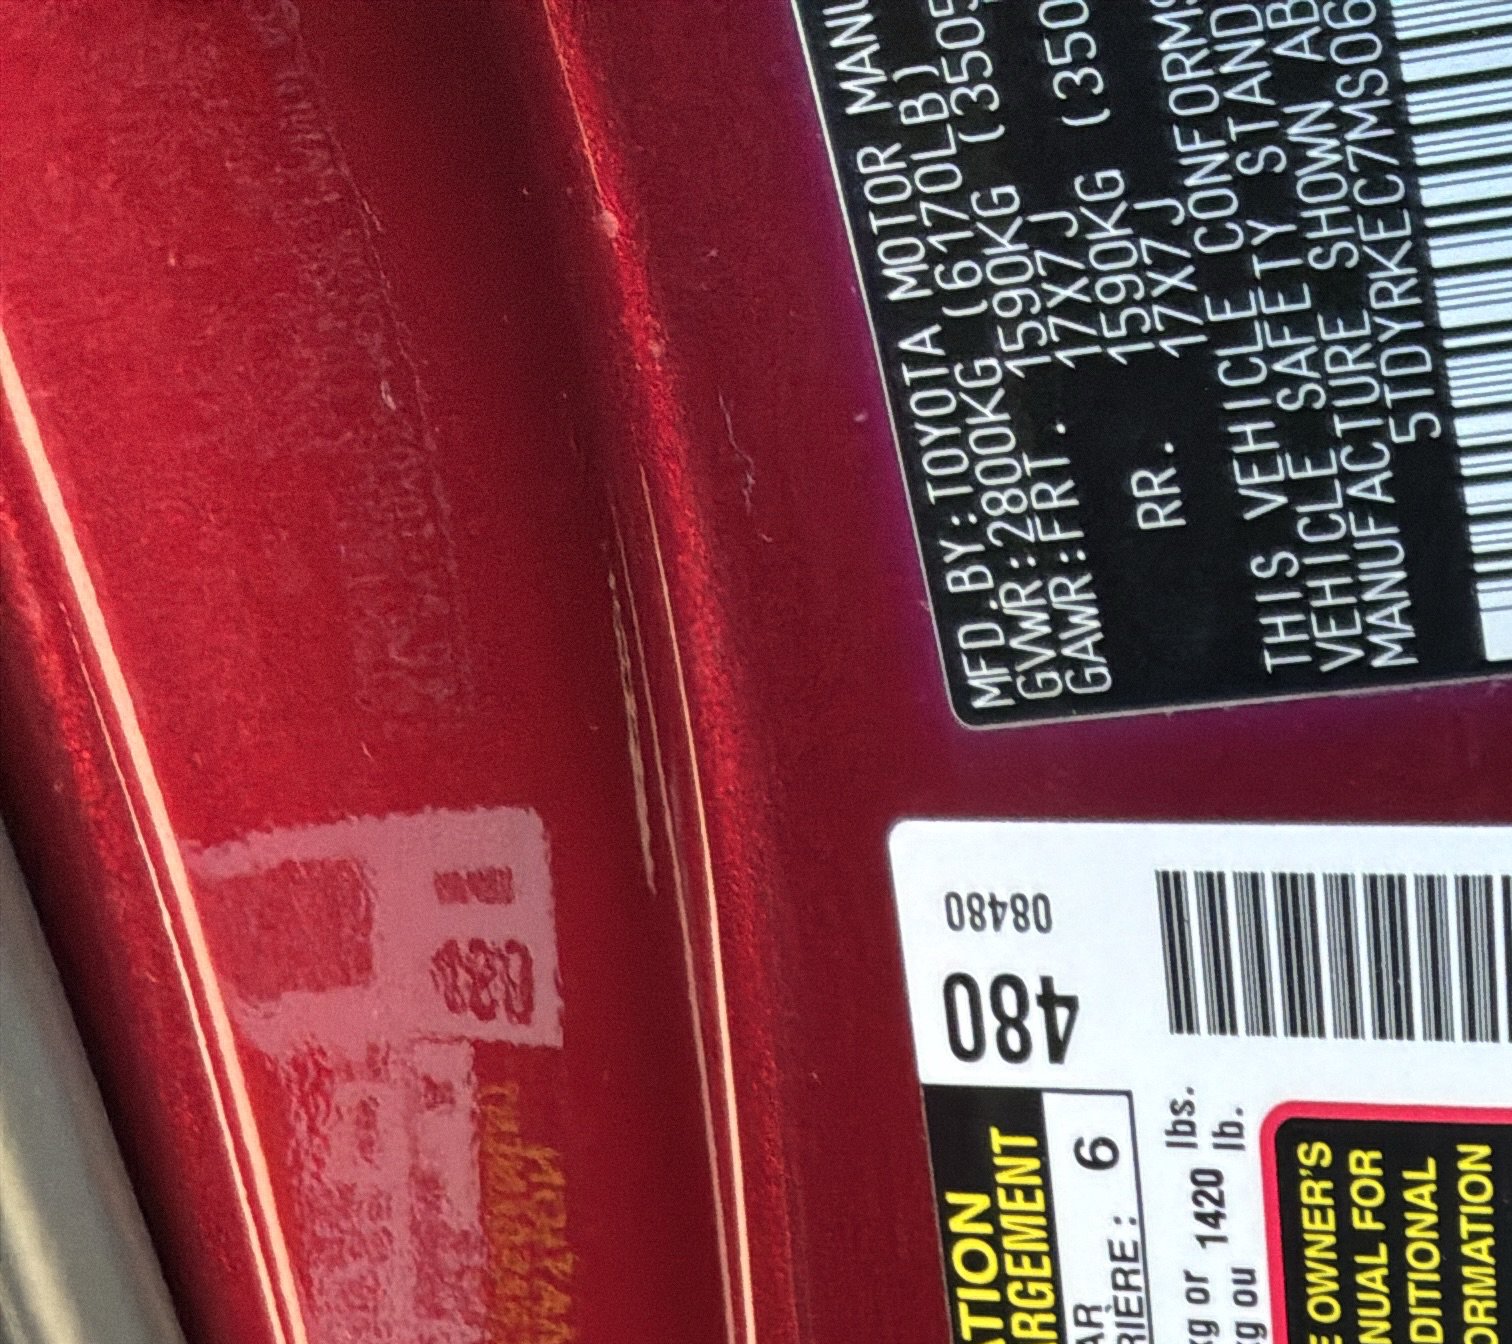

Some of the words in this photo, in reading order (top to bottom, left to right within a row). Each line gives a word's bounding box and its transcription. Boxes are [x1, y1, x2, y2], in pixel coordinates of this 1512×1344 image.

[1148, 0, 1246, 254] CONFORM
[1209, 2, 1288, 176] STAND
[854, 141, 934, 301] MOTOR
[891, 63, 989, 317] (6170LB)
[1283, 98, 1360, 270] SHOWN
[969, 183, 1053, 378] 1590KG
[1025, 209, 1103, 368] 17X7J
[1072, 167, 1156, 365] 1590KG
[1131, 196, 1209, 358] 17X7J
[1244, 218, 1328, 411] SAFETY
[1202, 288, 1289, 521] VEHICLE
[1283, 447, 1366, 672] VEHICLE
[1316, 308, 1419, 668] MANUFACTURE
[1248, 549, 1313, 673] THIS
[943, 889, 1053, 934] 08480
[941, 970, 1080, 1065] 480
[1072, 1135, 1120, 1171] 6
[1163, 1085, 1199, 1149] lbs.
[1210, 1106, 1246, 1151] lb.
[1347, 1148, 1386, 1231] FOR
[1182, 1268, 1211, 1305] or
[1188, 1166, 1229, 1249] 1420
[1230, 1266, 1259, 1308] ou
